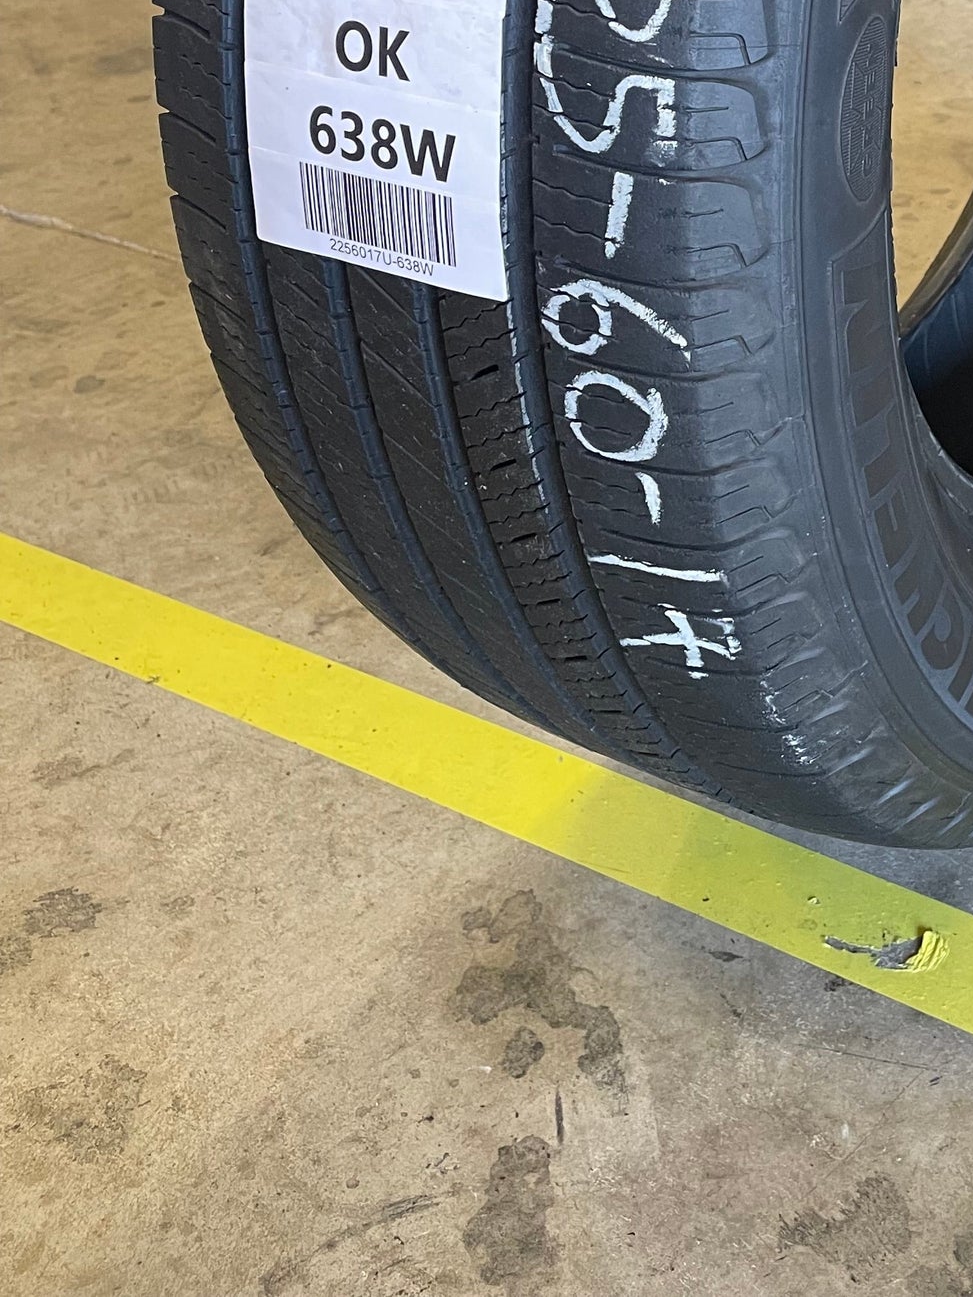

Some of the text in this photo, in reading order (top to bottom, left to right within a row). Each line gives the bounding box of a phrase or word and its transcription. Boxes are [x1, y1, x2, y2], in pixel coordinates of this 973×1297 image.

[335, 20, 410, 82] OK
[309, 105, 456, 183] 638W
[329, 238, 434, 277] 2256017U-638W
